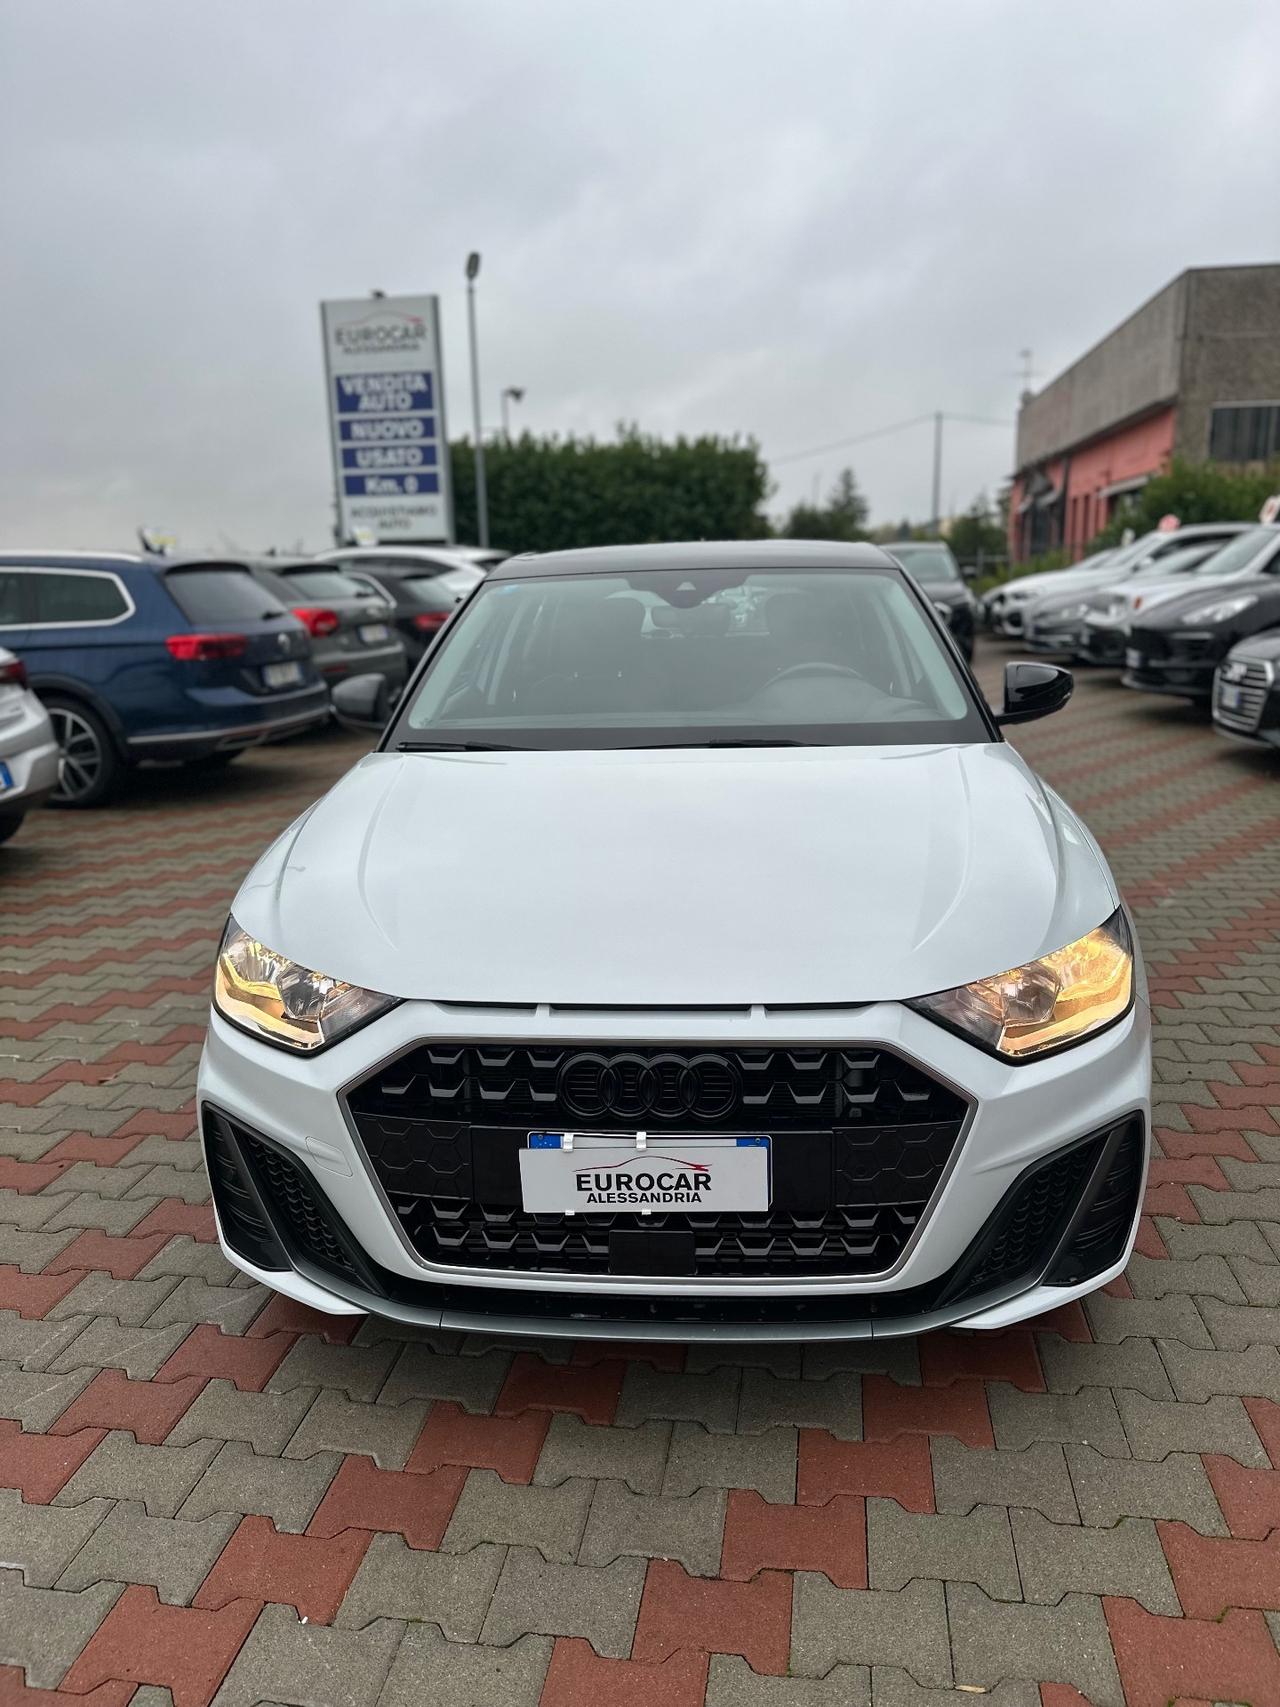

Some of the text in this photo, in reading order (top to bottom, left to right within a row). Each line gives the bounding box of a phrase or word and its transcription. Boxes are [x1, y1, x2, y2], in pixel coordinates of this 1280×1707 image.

[335, 325, 426, 345] EUROCAR
[341, 375, 427, 395] VENDITA
[358, 393, 412, 412] AUTO
[351, 420, 424, 440] NUOVO
[356, 446, 423, 467] USATO
[405, 475, 418, 494] 0
[576, 1172, 712, 1191] EUROCAR
[587, 1192, 702, 1203] ALESSANDRIA
